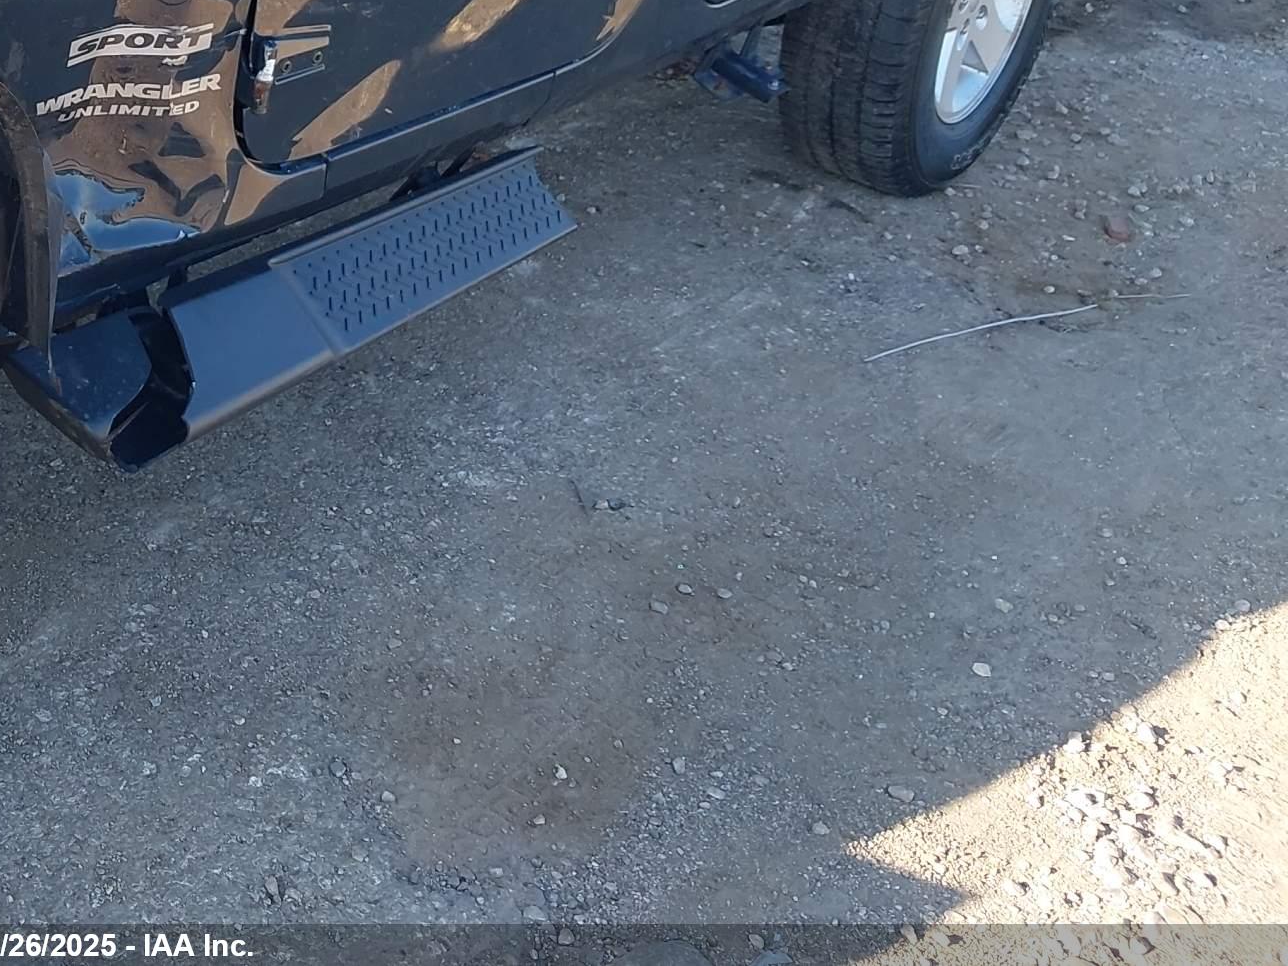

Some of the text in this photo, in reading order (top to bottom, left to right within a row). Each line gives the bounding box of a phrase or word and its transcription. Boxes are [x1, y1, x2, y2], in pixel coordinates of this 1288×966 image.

[77, 32, 206, 53] SPORT
[36, 73, 222, 116] WRANGLER
[58, 100, 200, 122] UNLIMITED
